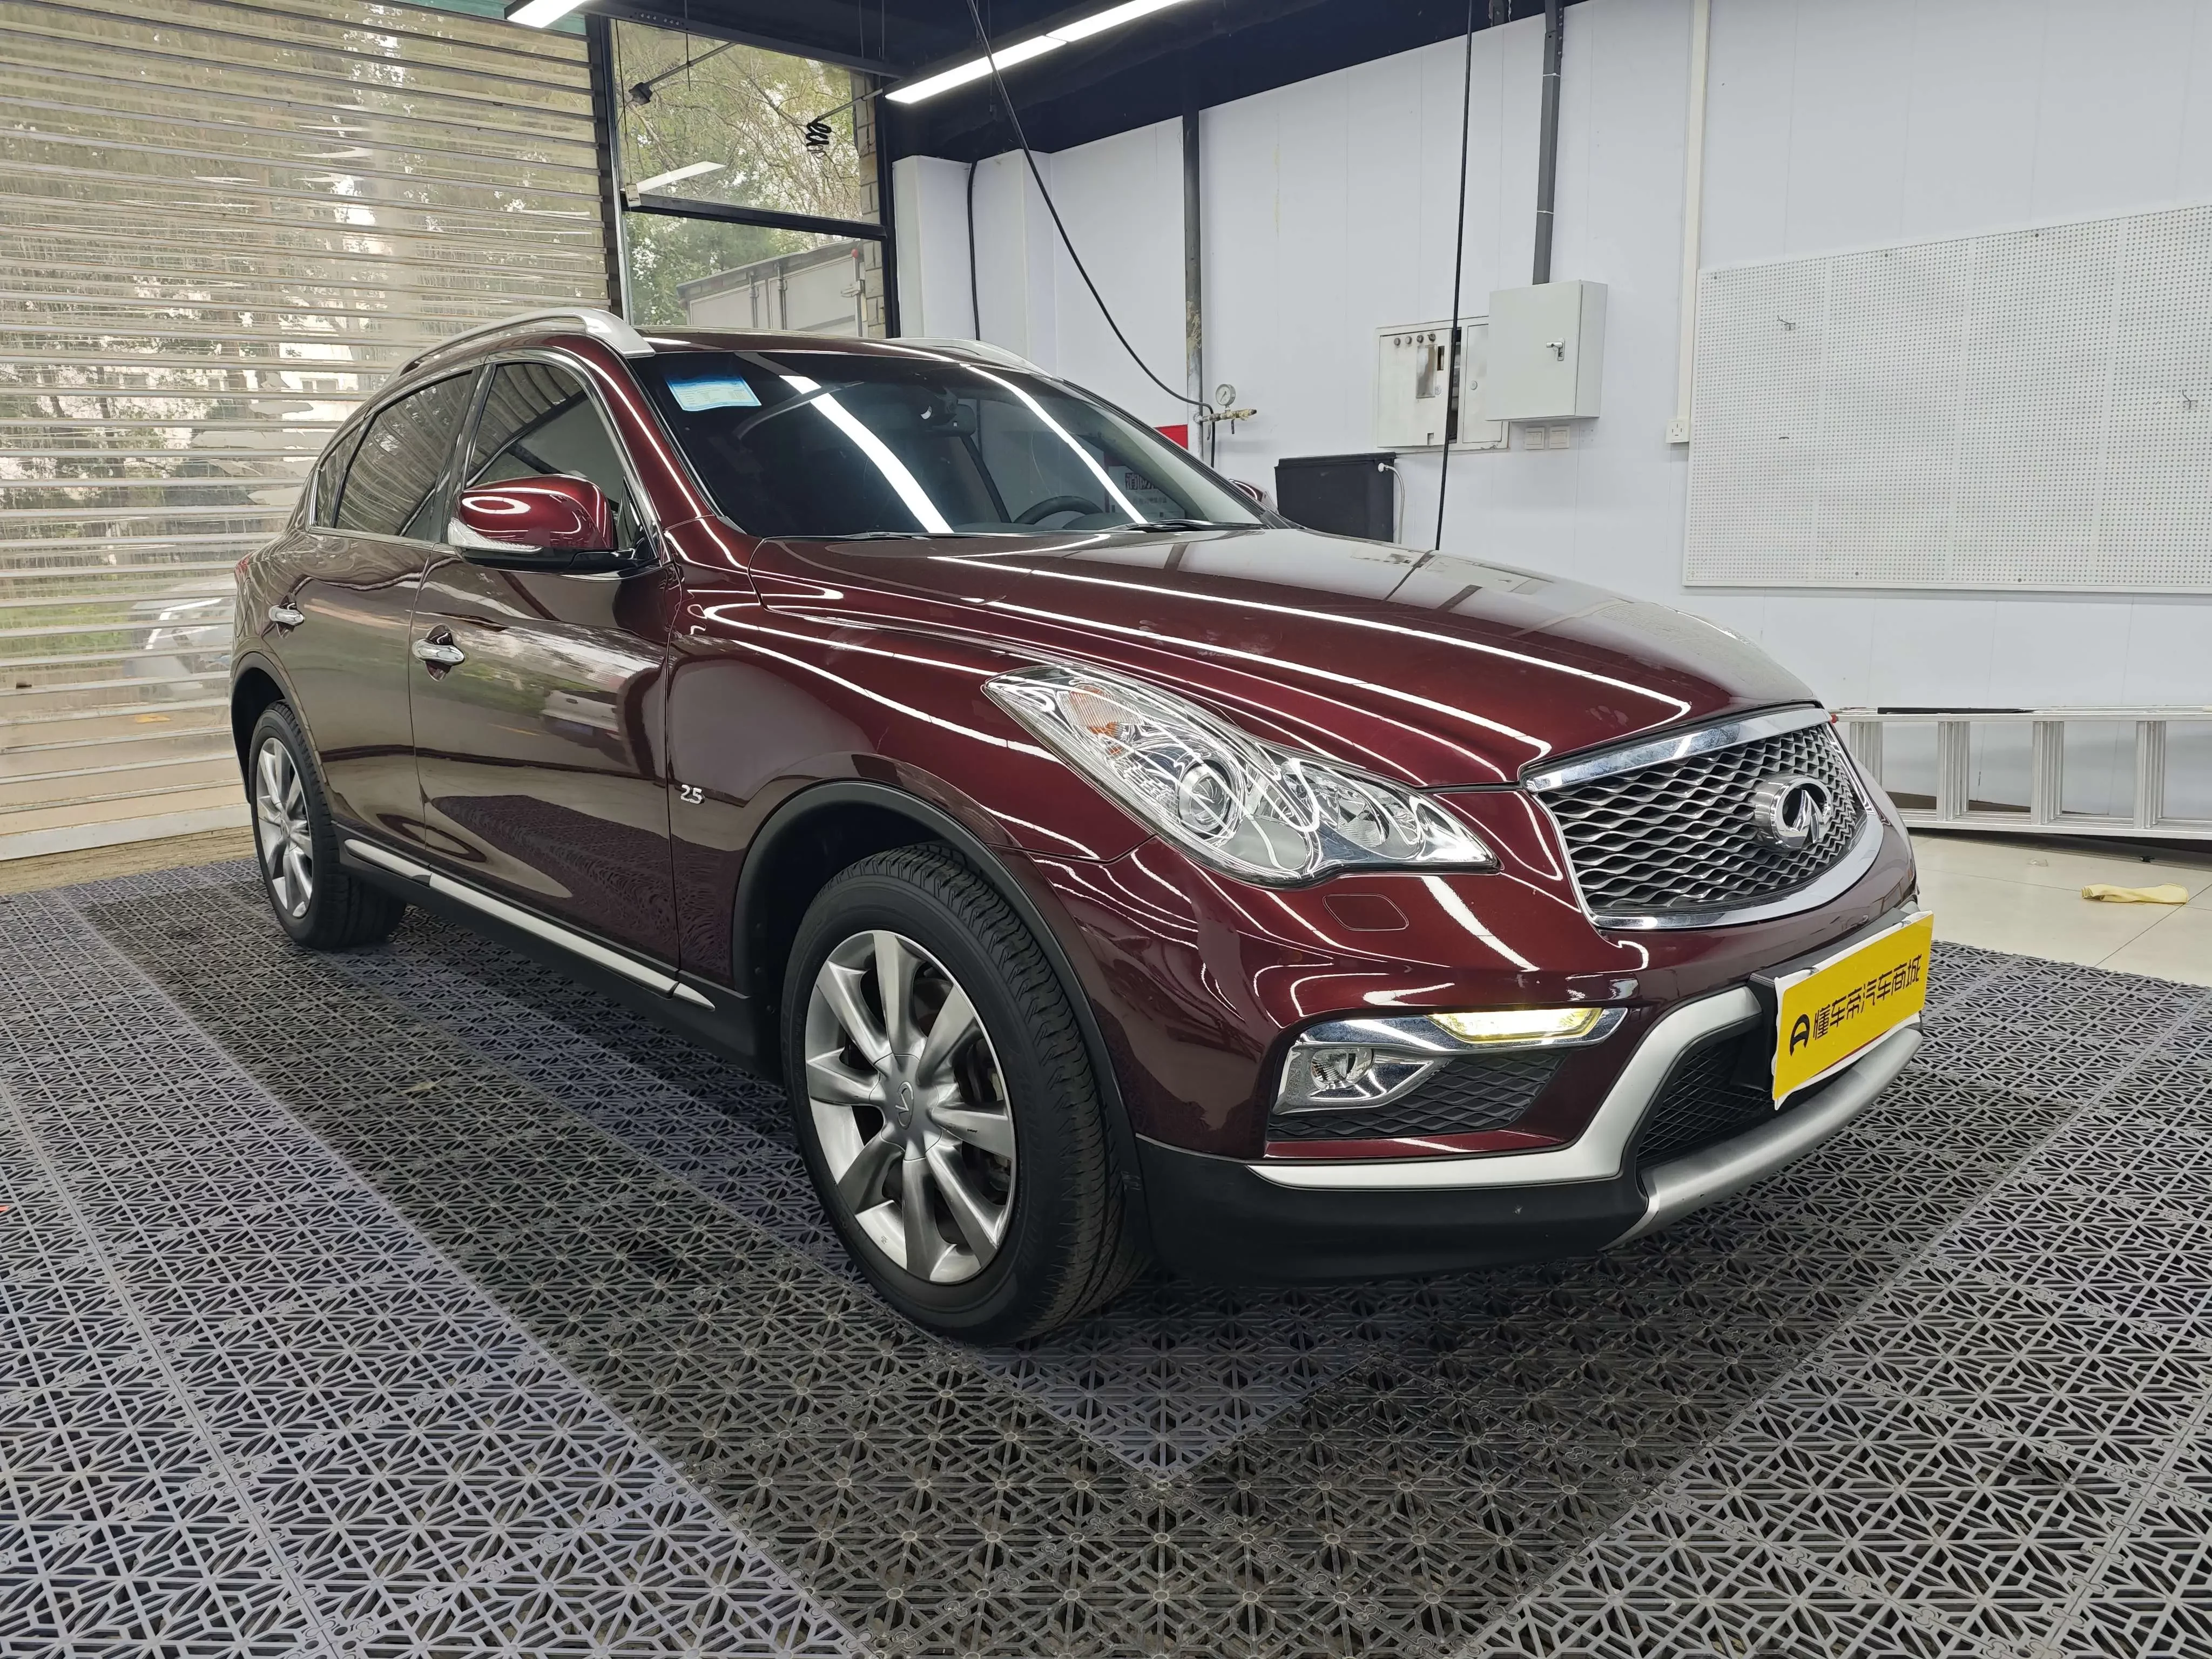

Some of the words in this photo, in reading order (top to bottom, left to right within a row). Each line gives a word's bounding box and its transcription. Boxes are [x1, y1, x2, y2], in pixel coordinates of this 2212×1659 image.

[1812, 954, 1923, 1041] 懂车帝汽车商城
